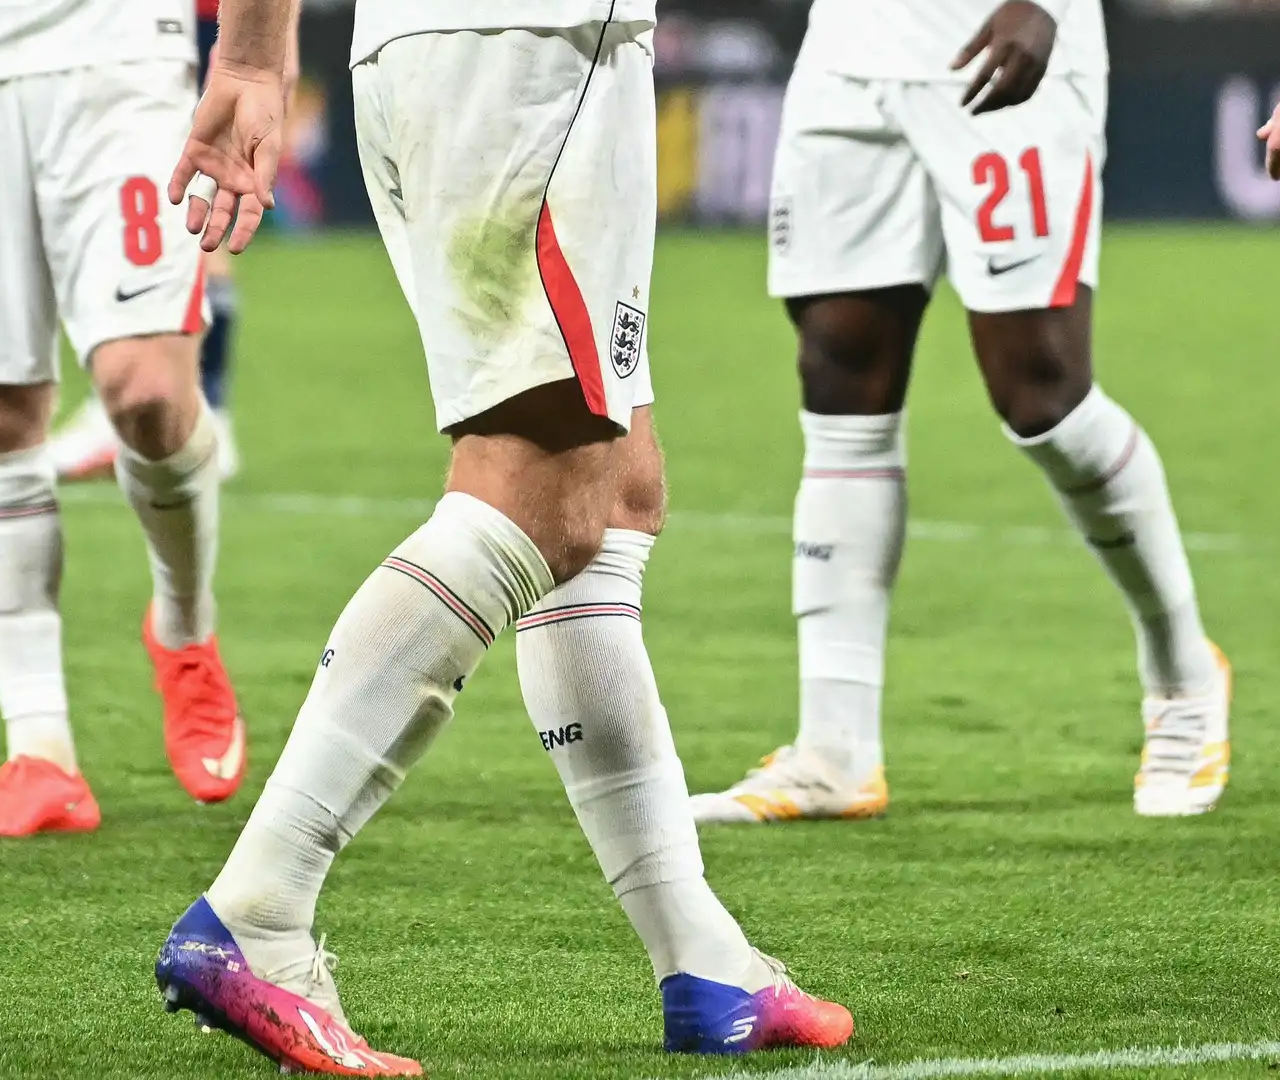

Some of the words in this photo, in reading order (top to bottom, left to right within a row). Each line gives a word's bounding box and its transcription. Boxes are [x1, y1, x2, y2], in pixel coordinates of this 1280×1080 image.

[118, 175, 164, 268] 8
[971, 145, 1050, 244] 21
[539, 722, 583, 751] ENG
